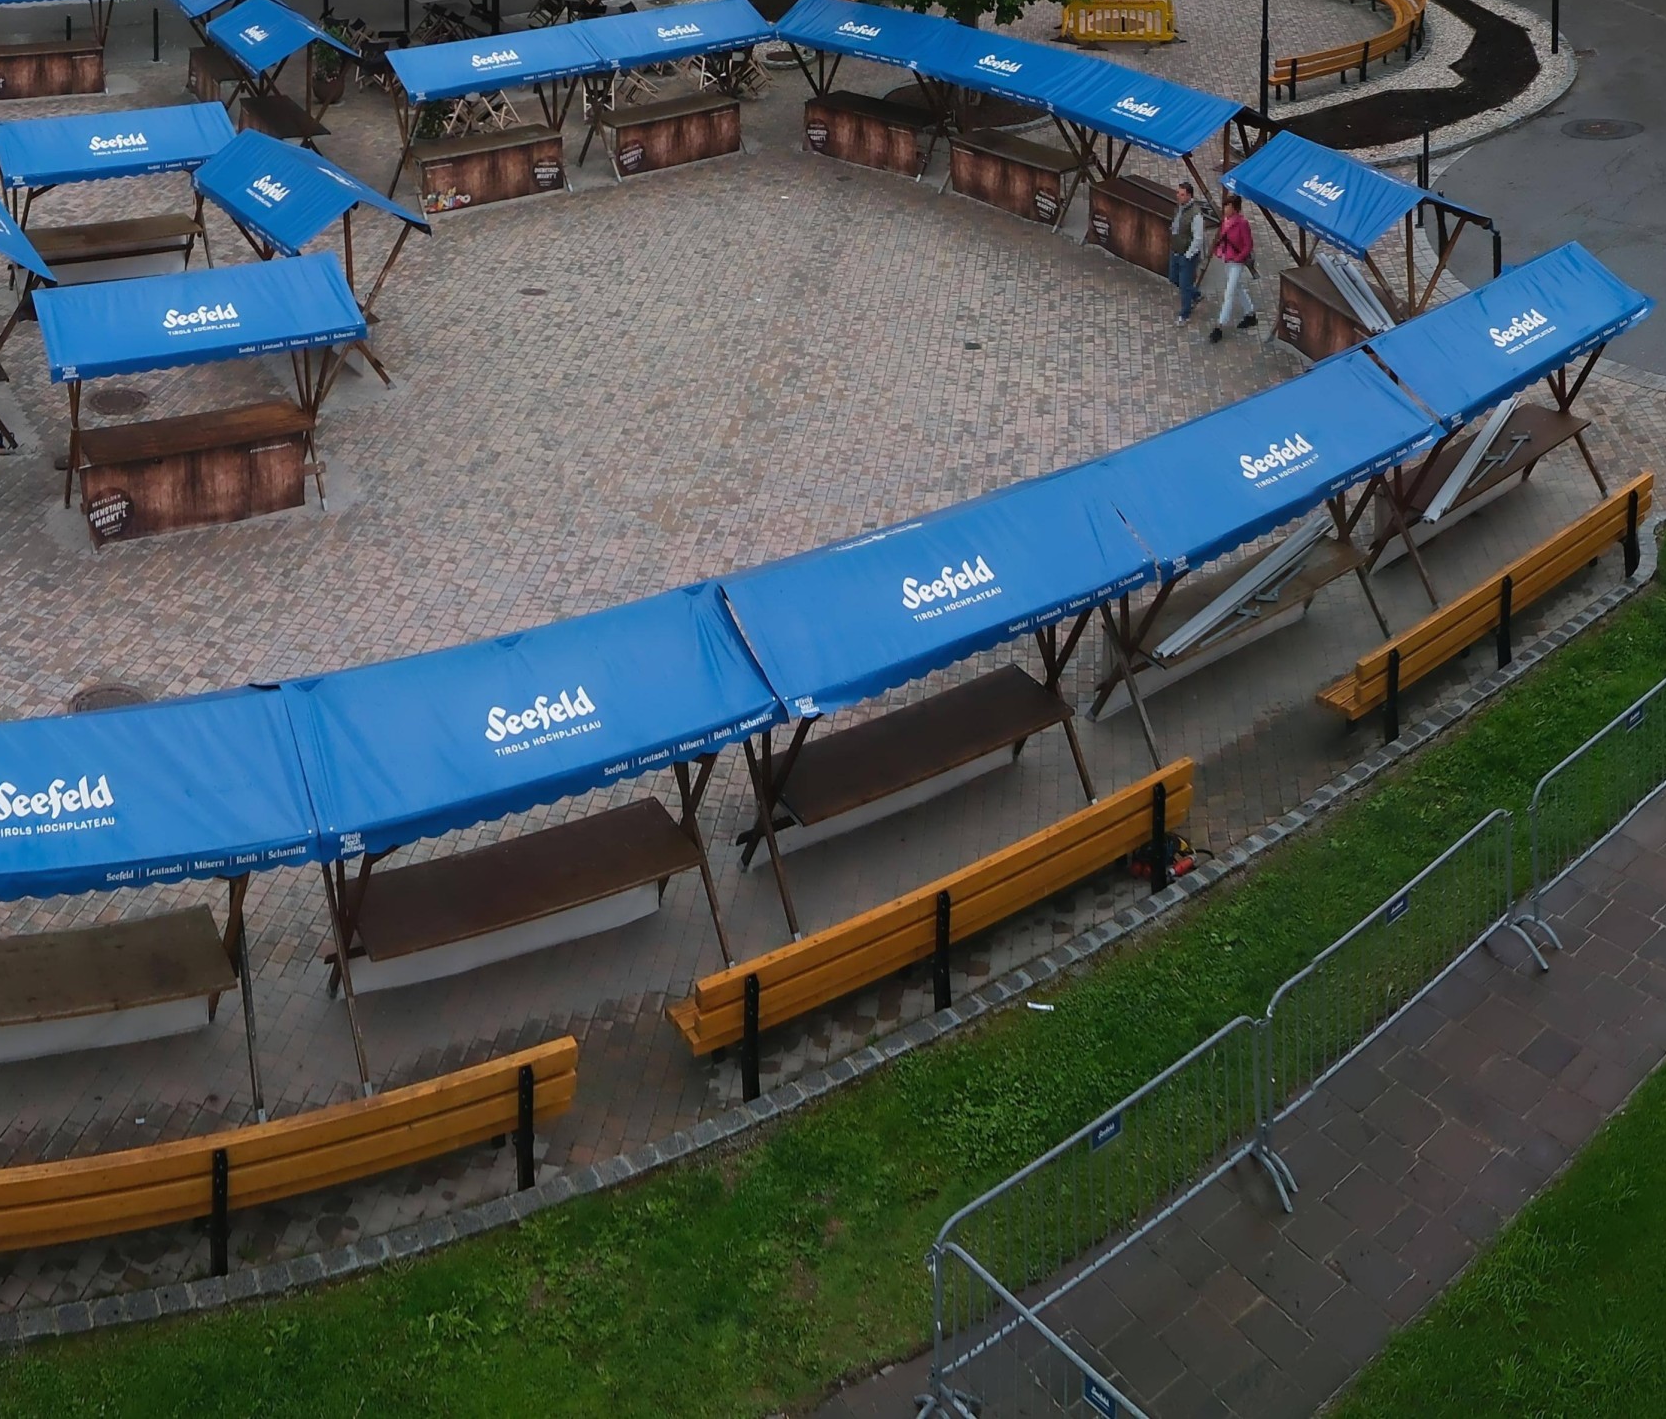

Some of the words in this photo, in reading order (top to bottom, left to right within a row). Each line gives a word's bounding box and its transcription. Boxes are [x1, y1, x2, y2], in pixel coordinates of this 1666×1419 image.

[657, 23, 700, 38] Seefeld
[839, 21, 882, 37] Seefeld
[471, 49, 519, 68] Seefeld
[978, 54, 1024, 73] Seefeld
[1116, 96, 1162, 118] Seefeld
[89, 132, 148, 152] Seefeld
[252, 174, 287, 202] Seefeld
[1302, 174, 1346, 202] Seefeld
[163, 303, 239, 329] Seefeld
[1489, 308, 1548, 349] Seefeld
[1239, 433, 1313, 479] Seefeld
[902, 555, 996, 610] Seefeld
[913, 609, 943, 623] TIROLS
[944, 586, 1003, 613] HOCHPLATEAU
[484, 685, 596, 744] Seefeld
[495, 740, 530, 757] TIROLS
[533, 719, 602, 747] HOCHPLATEAU
[604, 761, 629, 777] Seefeld
[638, 748, 670, 766] Leutasch
[679, 737, 705, 754] Mösern
[714, 725, 732, 741] Reith
[739, 713, 773, 732] Scharnitz
[36, 816, 116, 835] HOCHPLATEAU
[106, 869, 134, 882] Seefeld
[146, 863, 183, 877] Leutasch
[194, 858, 224, 871] Mösern
[237, 853, 258, 865] Reith
[268, 844, 307, 860] Scharnitz
